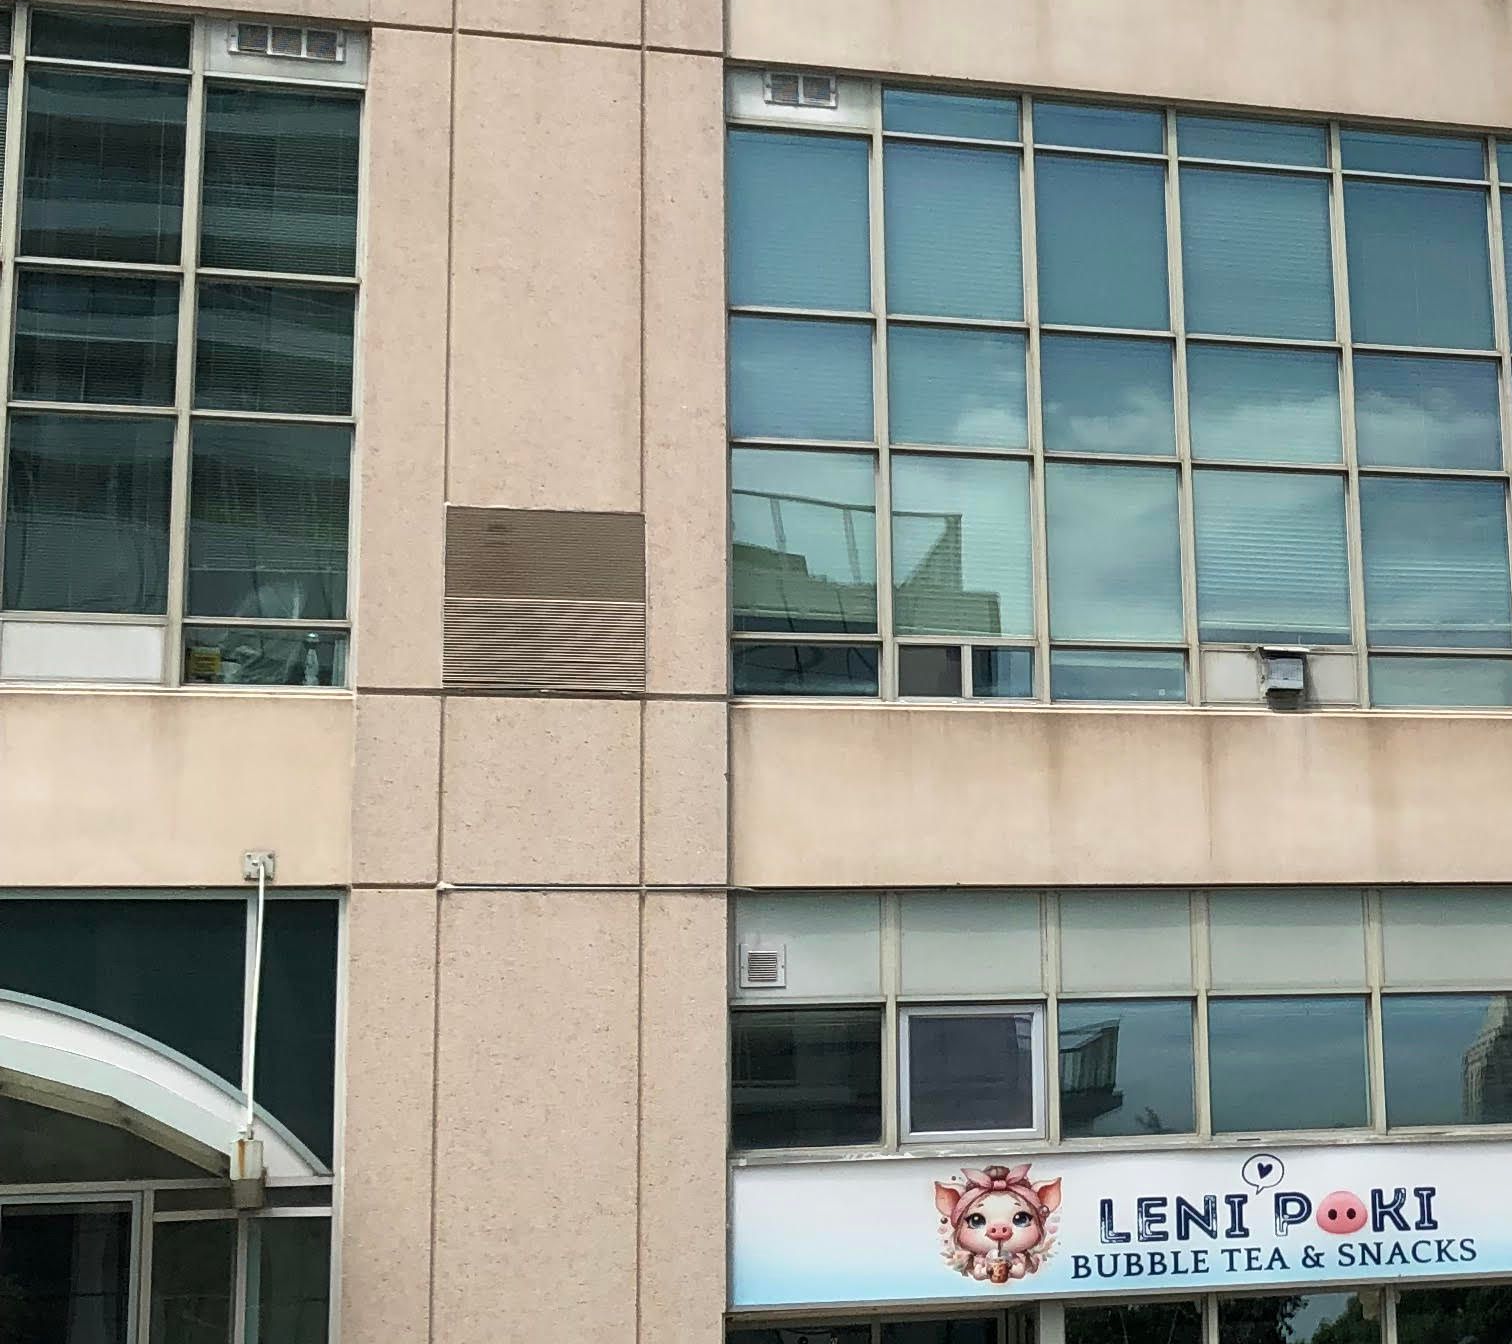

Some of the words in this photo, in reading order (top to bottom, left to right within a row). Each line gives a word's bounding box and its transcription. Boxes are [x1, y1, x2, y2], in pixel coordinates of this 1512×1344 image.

[1100, 1193, 1250, 1244] LENI
[1071, 1249, 1210, 1279] BUBBLE
[1220, 1246, 1290, 1273] TEA
[1301, 1244, 1326, 1269] &
[1337, 1237, 1478, 1267] SNACKS
